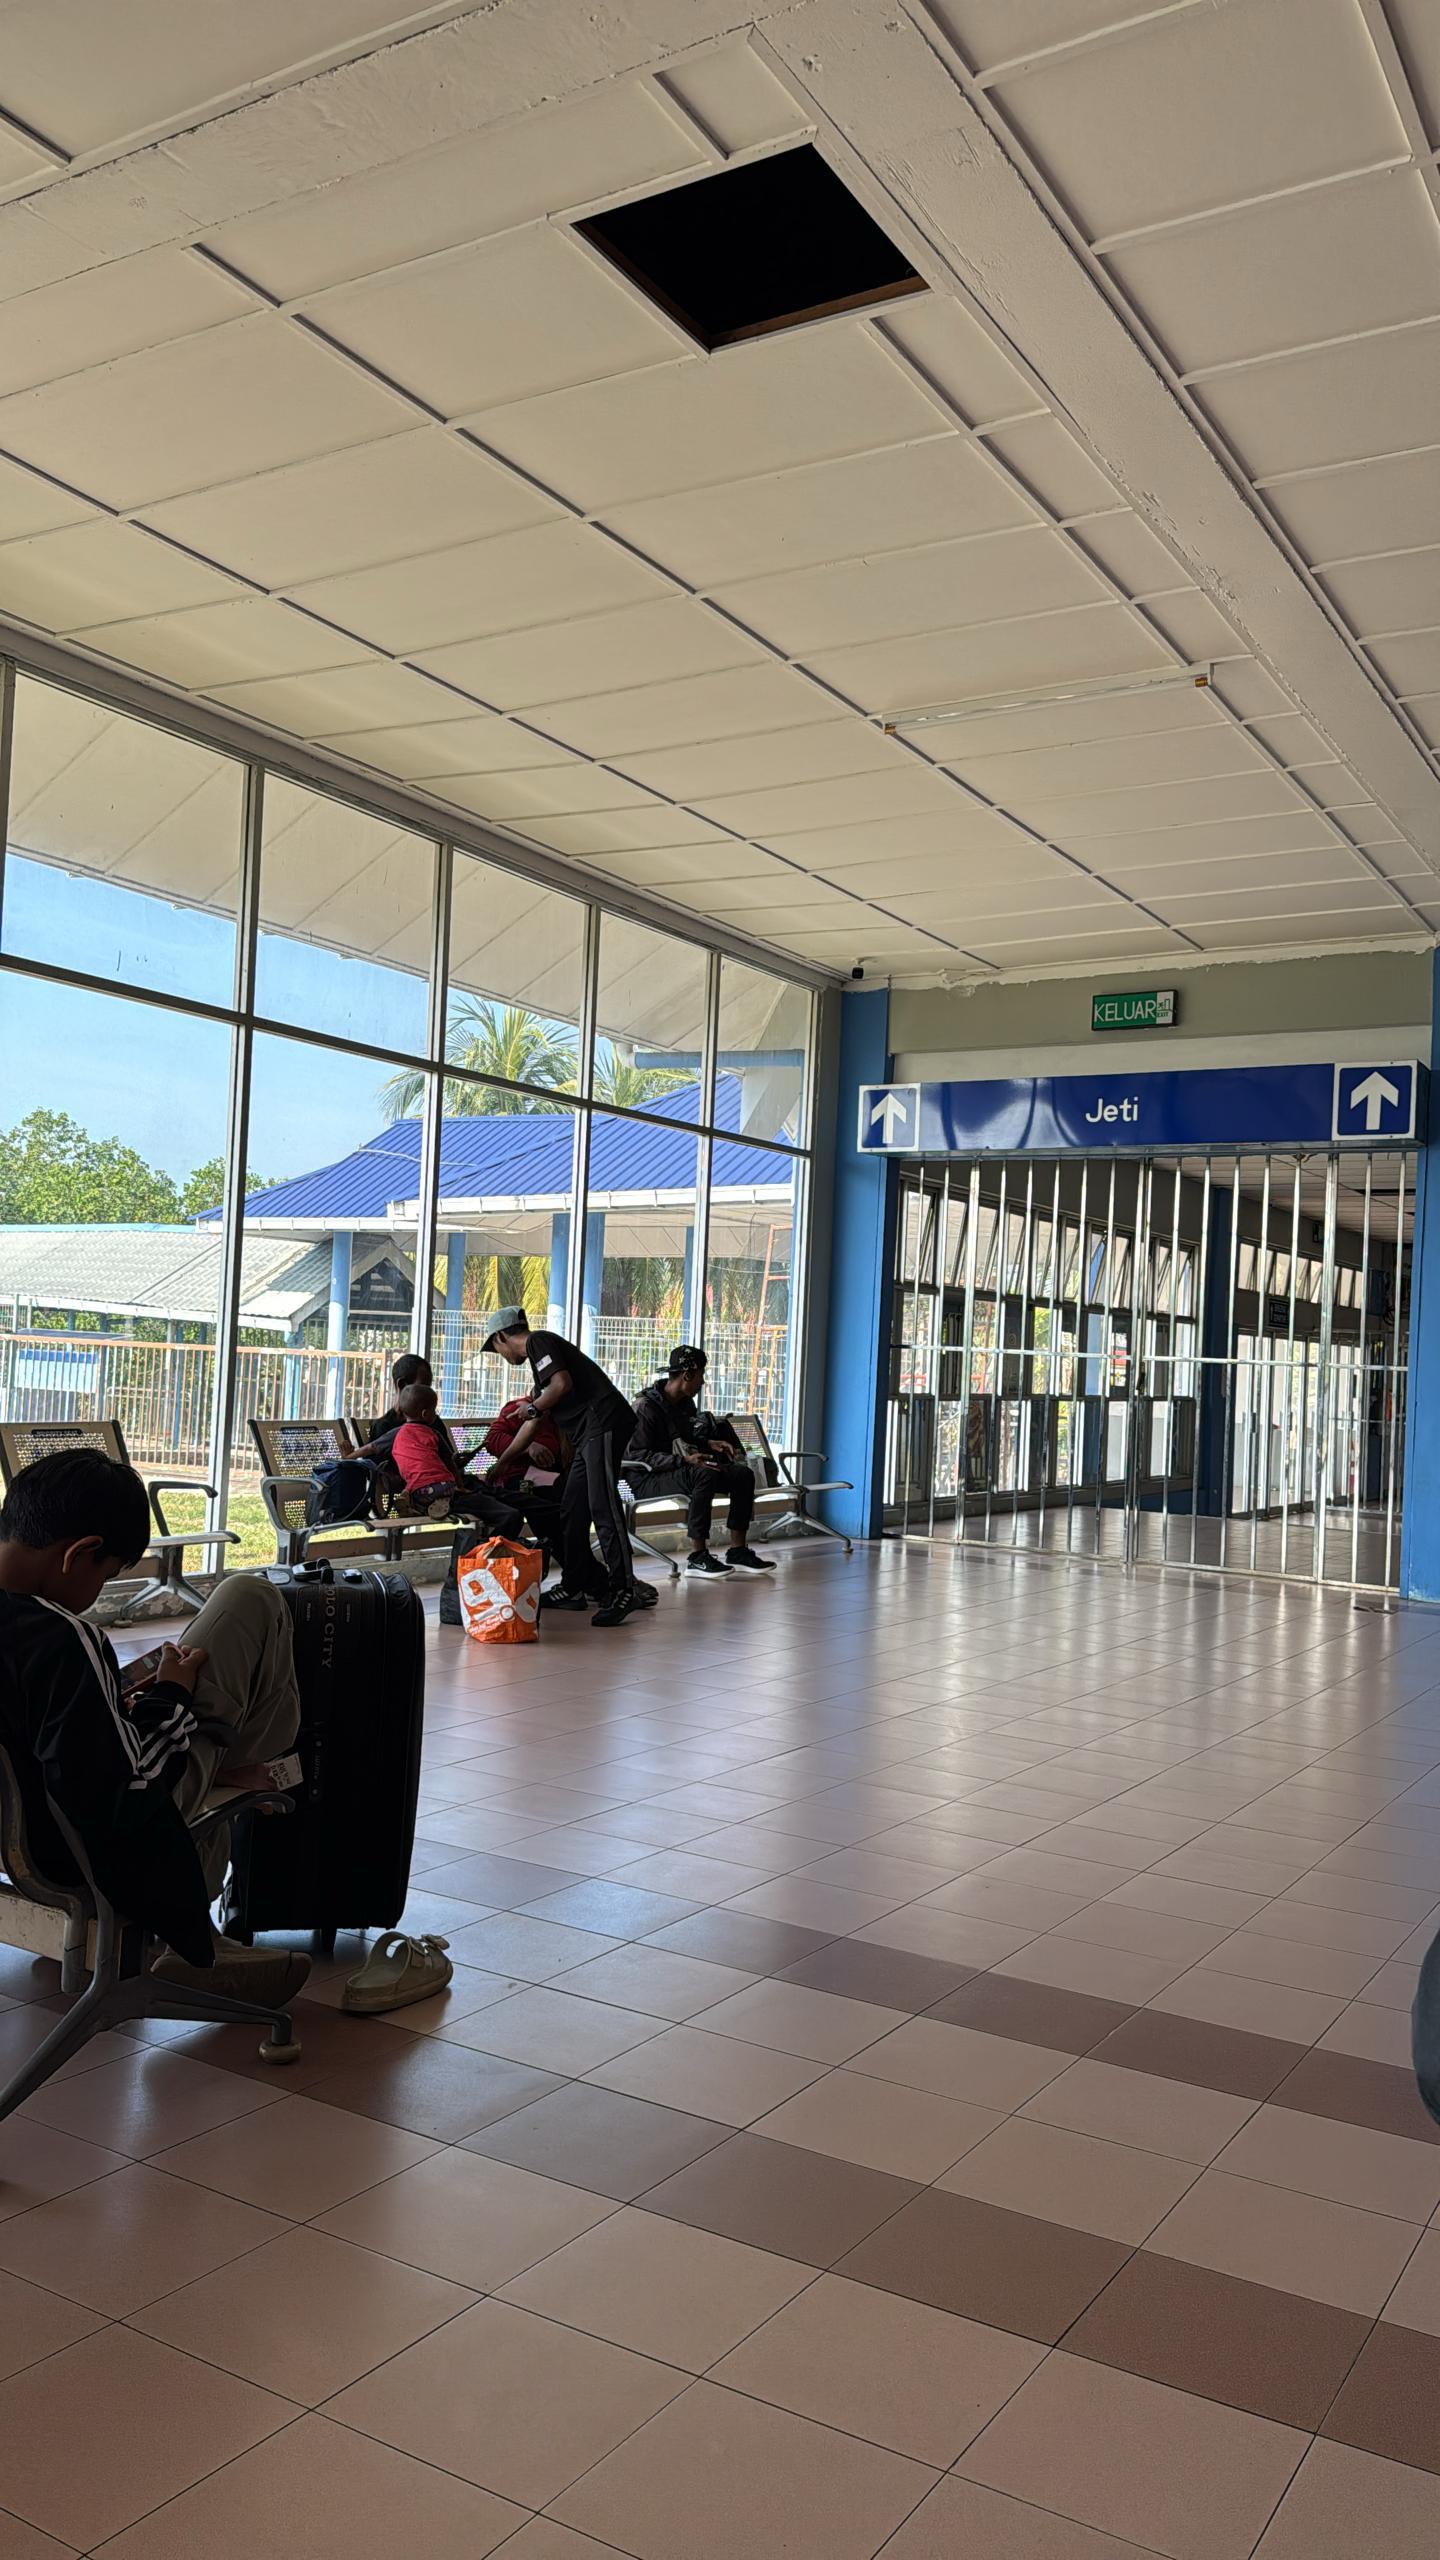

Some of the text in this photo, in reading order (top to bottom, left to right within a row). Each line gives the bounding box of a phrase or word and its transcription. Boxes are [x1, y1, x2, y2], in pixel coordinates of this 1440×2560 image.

[1094, 1000, 1156, 1022] KELUAR
[1085, 1096, 1139, 1123] Jeti
[321, 1622, 335, 1668] CITY
